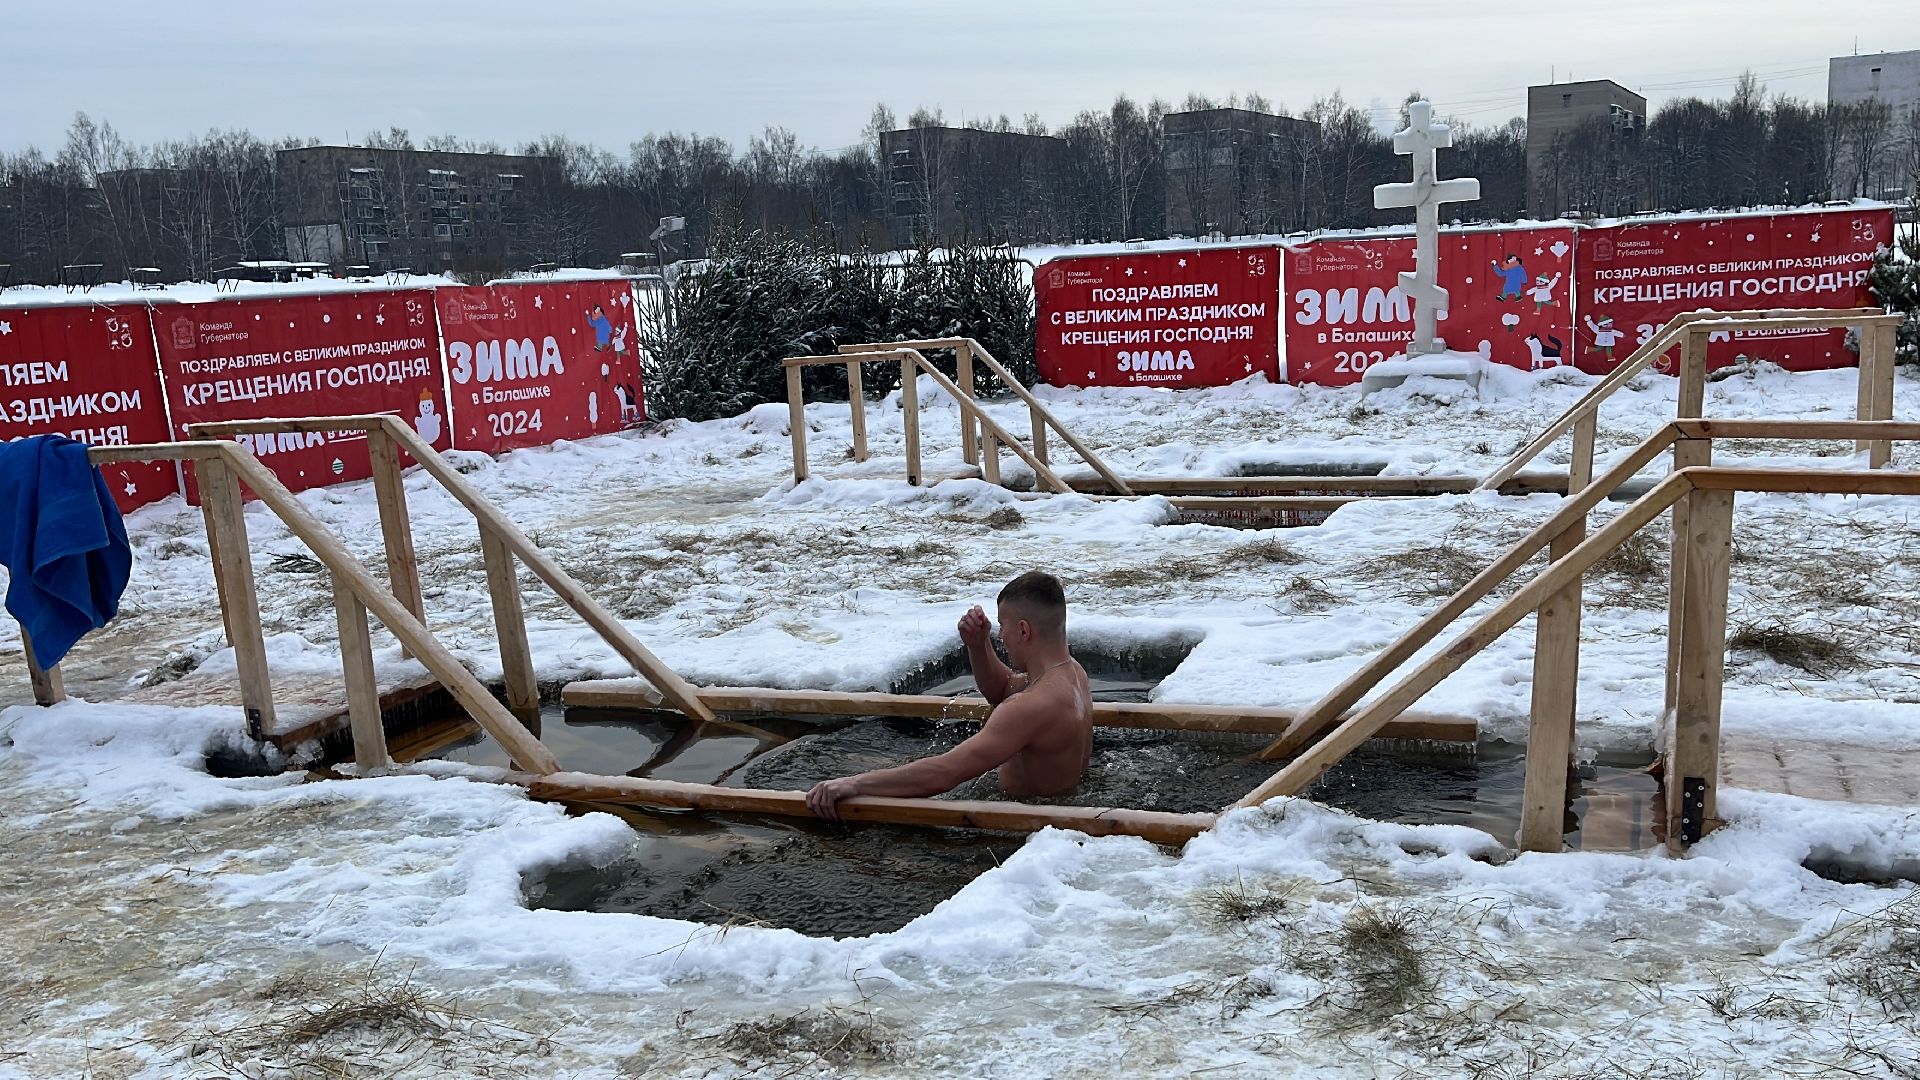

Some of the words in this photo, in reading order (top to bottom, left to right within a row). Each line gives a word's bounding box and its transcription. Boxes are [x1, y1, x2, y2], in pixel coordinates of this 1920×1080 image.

[1595, 265, 1694, 281] ПОЗДРАВЛЯЕМ
[1697, 264, 1706, 274] С
[1709, 260, 1773, 273] ВЕЛИКИМ
[1775, 251, 1875, 269] ПРАЗДНИКОМ
[1092, 283, 1218, 303] ПОЗДРАВЛЯЕМ
[1593, 280, 1724, 304] КРЕЩЕНИЯ
[1051, 312, 1061, 325] С
[1065, 308, 1142, 325] ВЕЛИКИМ
[1145, 302, 1265, 322] ПРАЗДНИКОМ
[1295, 286, 1449, 325] ЗИМ
[200, 322, 233, 331] Команда
[1061, 329, 1150, 346] КРЕЩЕНИЯ
[1154, 326, 1253, 343] ГОСПОДНЯ!
[1318, 333, 1327, 343] в
[1331, 327, 1416, 343] Балаших
[200, 332, 249, 344] Губернатора
[180, 352, 280, 374] ПОЗДРАВЛЯЕМ
[283, 351, 293, 363] С
[294, 345, 350, 362] ВЕЛИКИМ
[352, 338, 425, 355] ПРАЗДНИКОМ
[449, 336, 564, 384] ЗИМА
[1117, 350, 1195, 371] ЗИМА
[183, 371, 313, 407] КРЕЩЕНИЯ
[316, 357, 431, 390] ГОСПОДНЯ!
[1136, 373, 1182, 382] Балашихе
[472, 392, 480, 405] в
[482, 385, 551, 404] Балашихе
[488, 408, 543, 437] 2024
